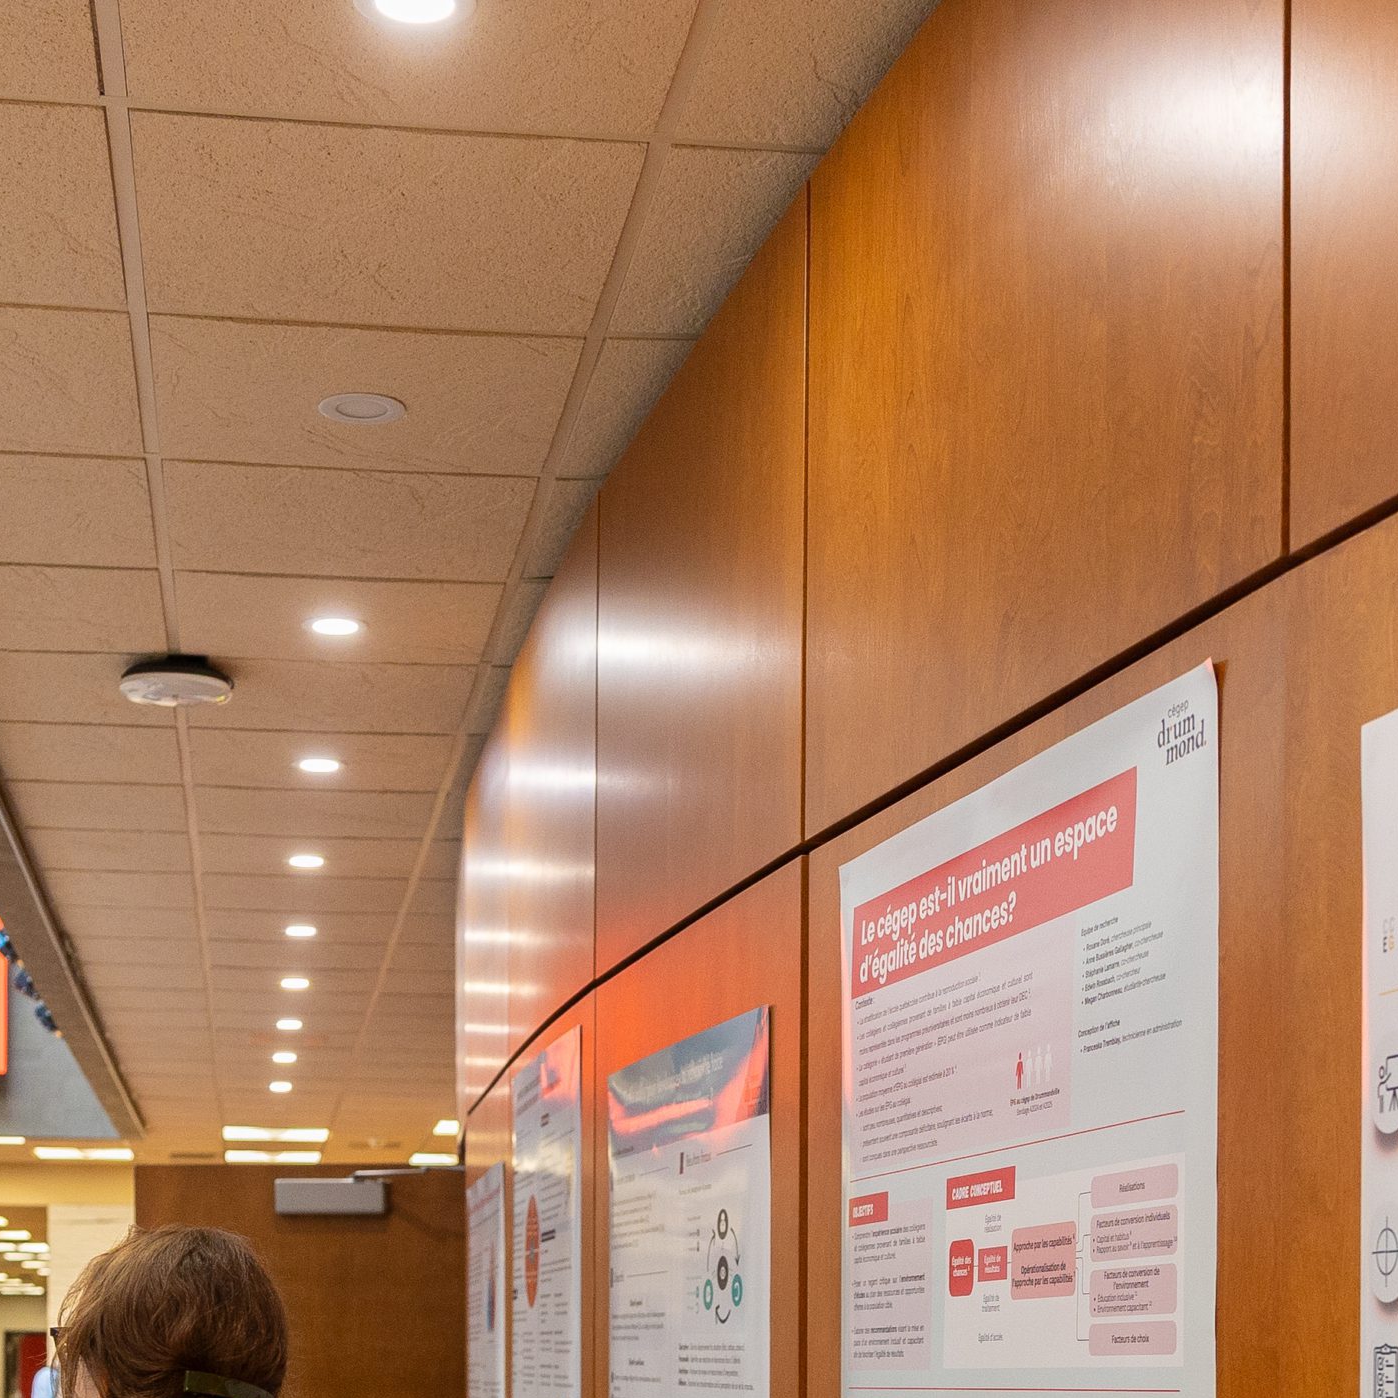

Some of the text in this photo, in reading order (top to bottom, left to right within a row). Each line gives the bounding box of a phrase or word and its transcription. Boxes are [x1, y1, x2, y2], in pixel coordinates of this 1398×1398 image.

[1168, 699, 1189, 718] cégep
[1157, 713, 1195, 748] drum
[1165, 720, 1207, 766] mond.
[861, 807, 1116, 944] Le cégep est-il vraiment un espace
[860, 892, 1015, 981] d'égalité des chances?
[952, 1180, 1002, 1199] CADRE CONCEPTUEL
[1112, 1335, 1129, 1343] Facteurs
